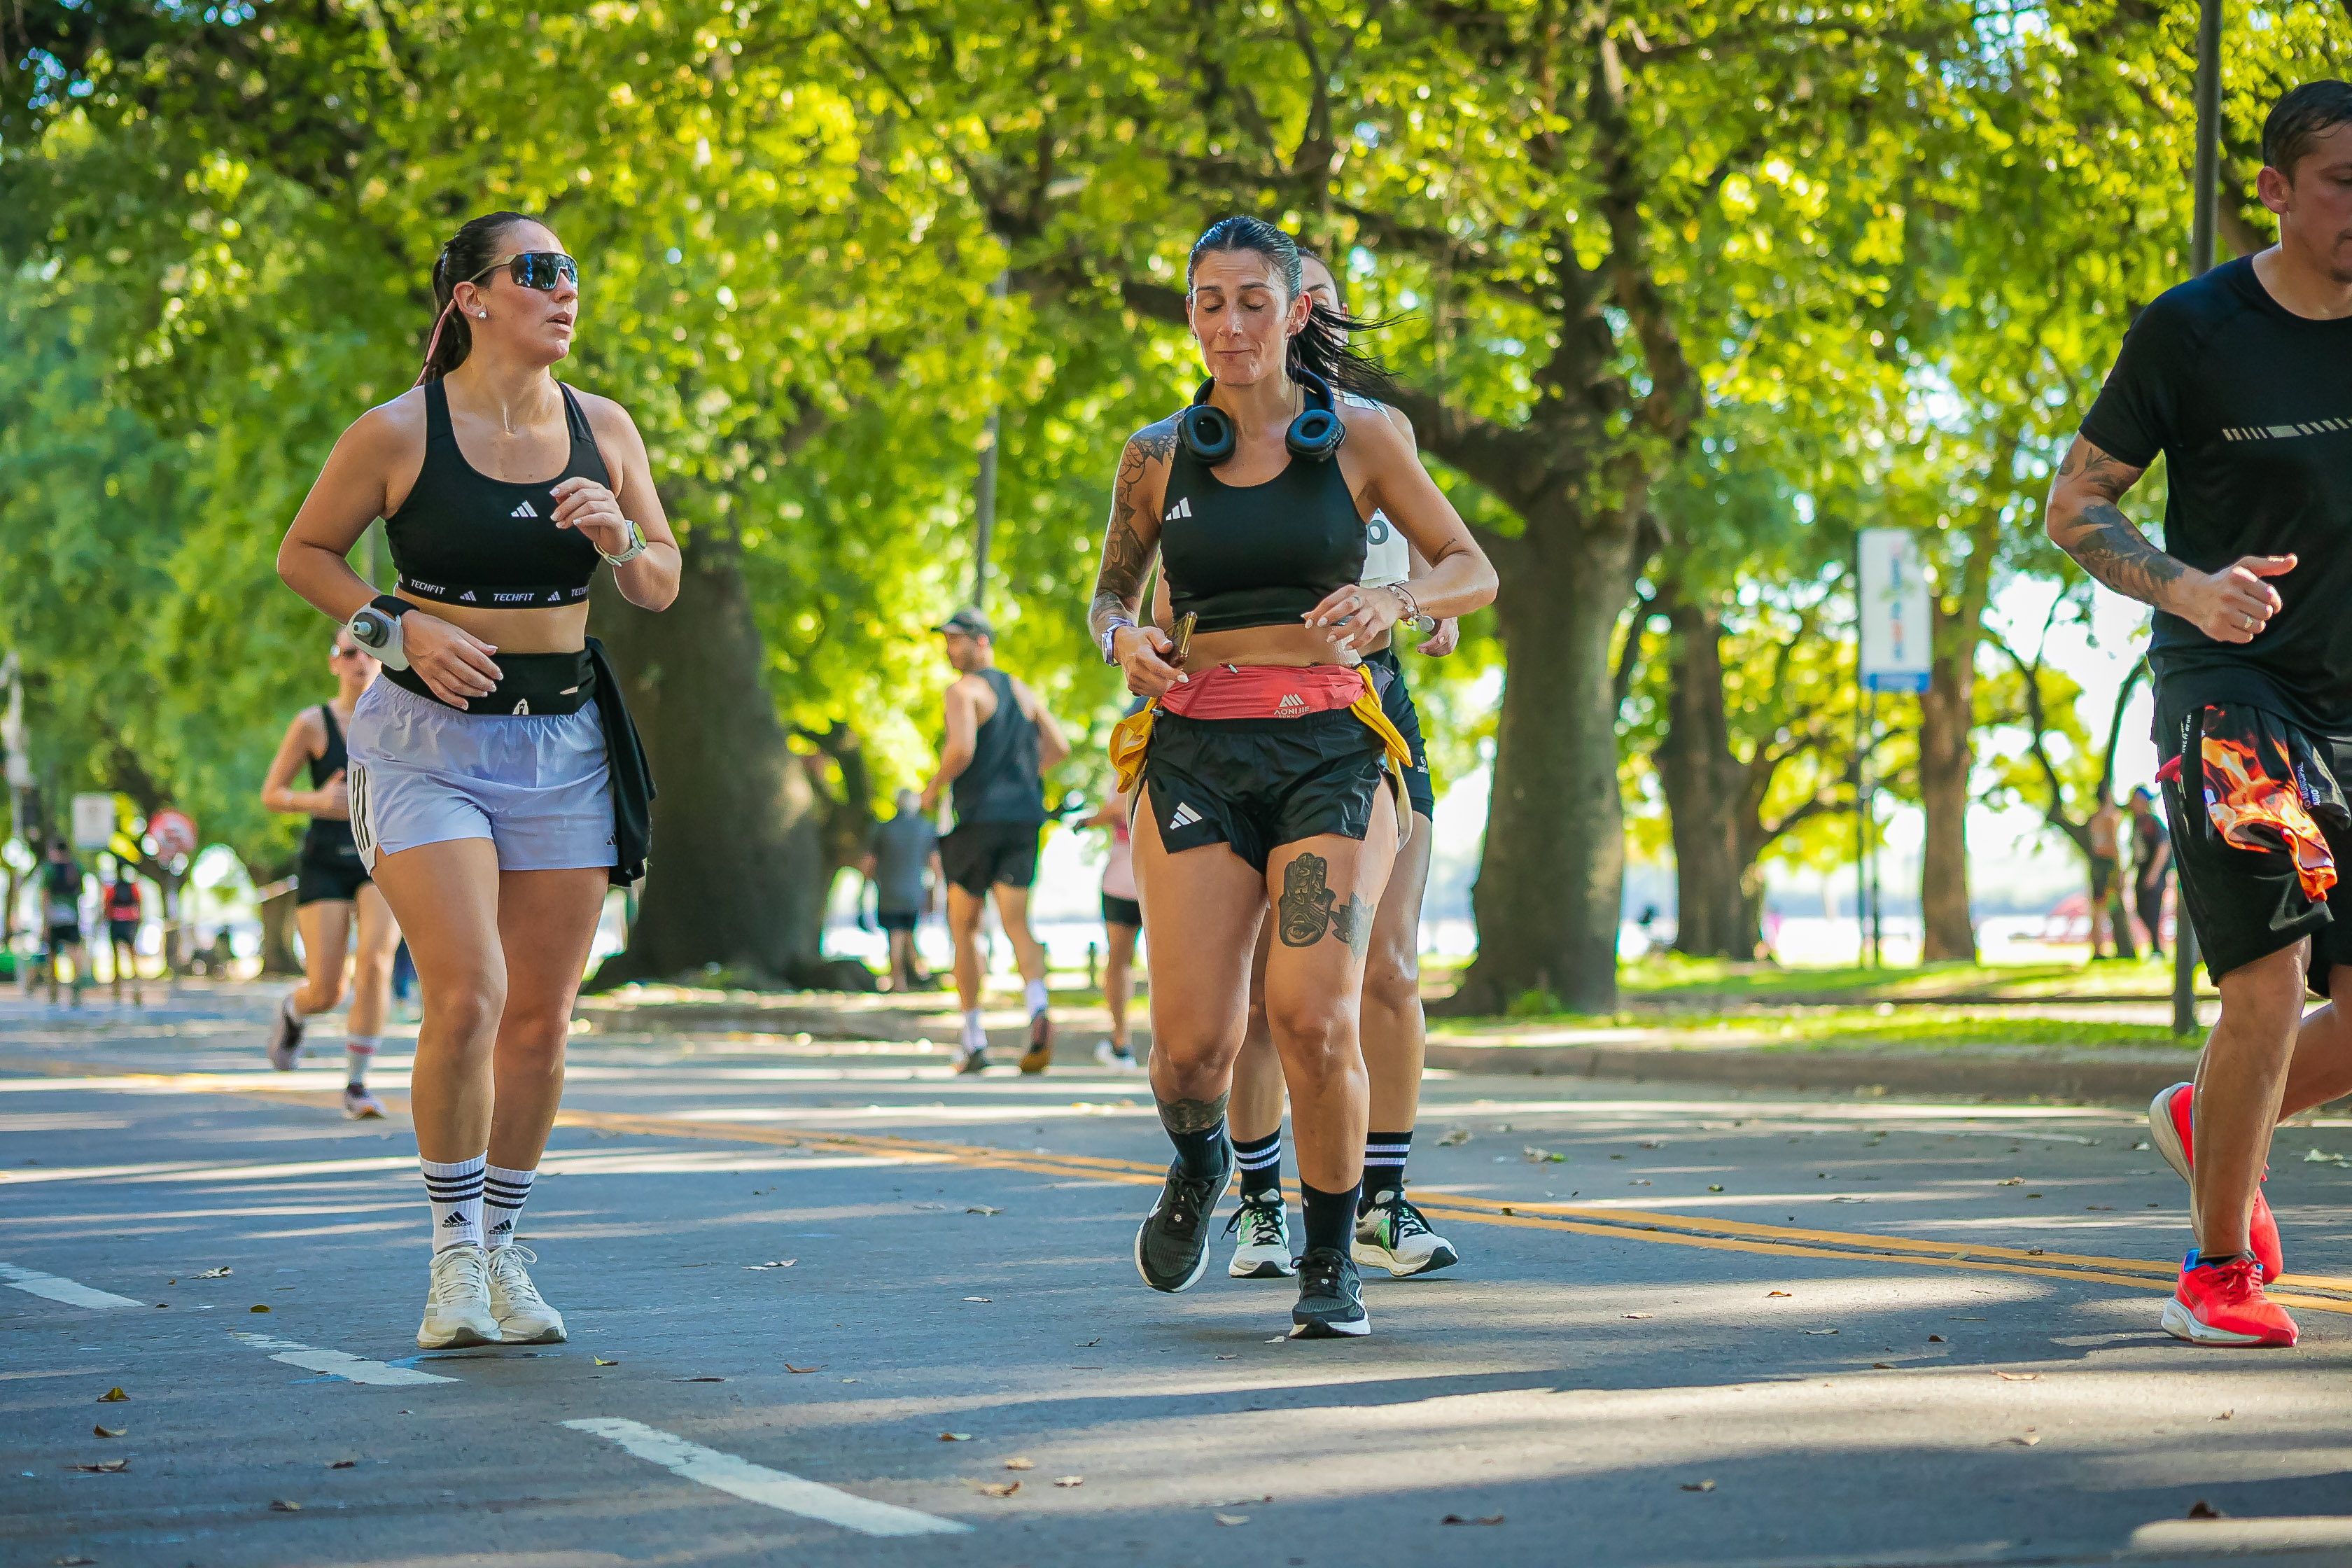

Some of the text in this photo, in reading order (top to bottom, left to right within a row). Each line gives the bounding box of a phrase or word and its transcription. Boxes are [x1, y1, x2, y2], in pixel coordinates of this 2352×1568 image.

[411, 579, 446, 595] TECHFIT
[493, 593, 535, 601] TECHFIT
[1273, 706, 1310, 715] AONIJIE
[2296, 762, 2310, 799] MUNICIPAL
